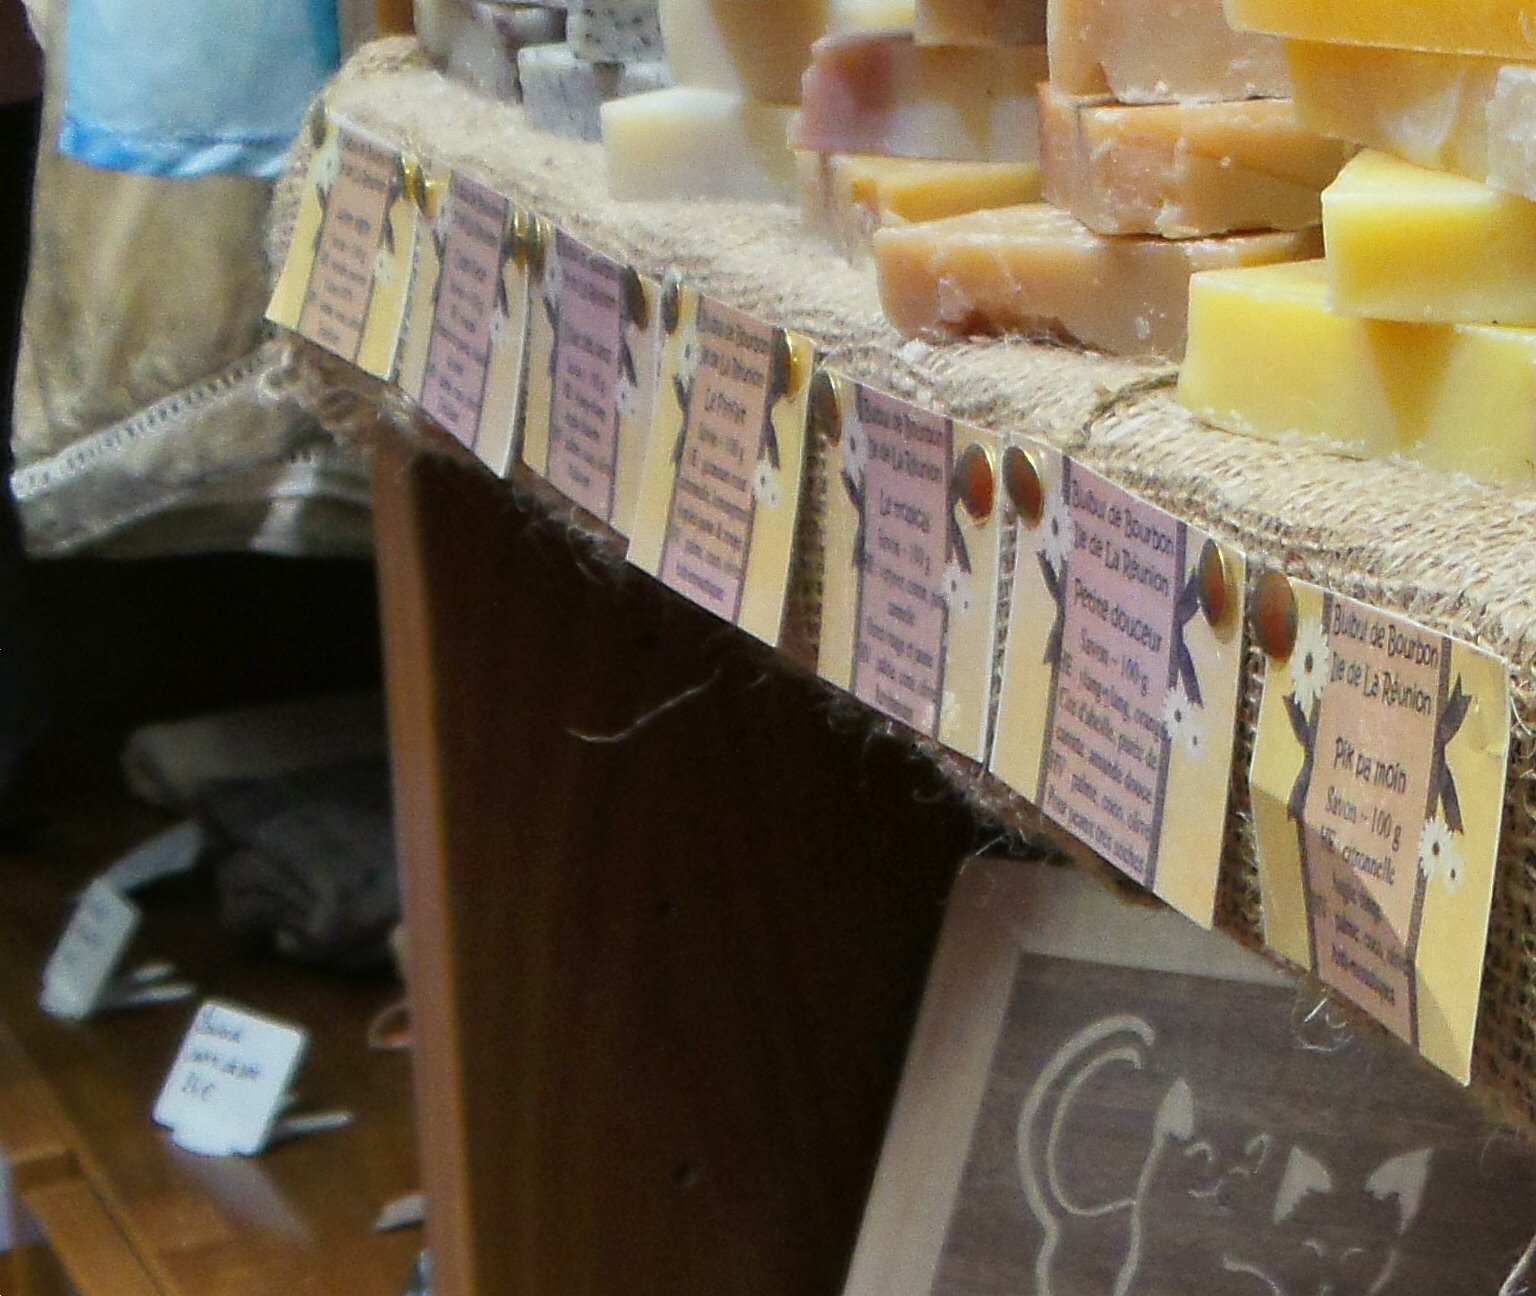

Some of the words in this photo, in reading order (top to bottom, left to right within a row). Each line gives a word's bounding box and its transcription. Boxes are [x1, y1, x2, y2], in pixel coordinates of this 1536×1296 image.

[1371, 620, 1385, 649] de
[1388, 624, 1439, 667] Bourbon
[1347, 662, 1362, 687] de
[1364, 664, 1379, 697] La
[1382, 671, 1431, 715] Réunion
[1371, 806, 1393, 839] 100
[1392, 825, 1402, 852] g
